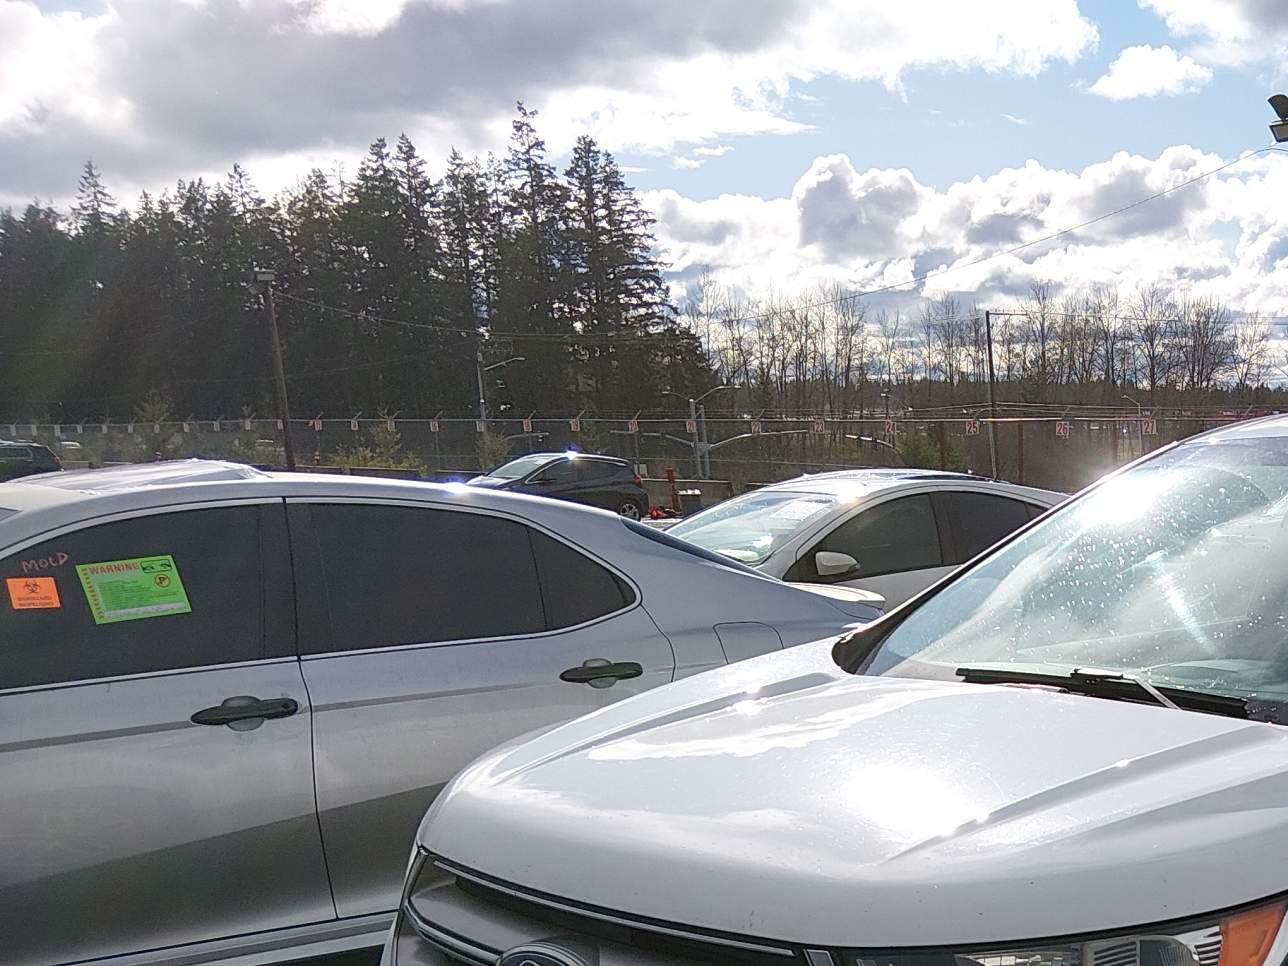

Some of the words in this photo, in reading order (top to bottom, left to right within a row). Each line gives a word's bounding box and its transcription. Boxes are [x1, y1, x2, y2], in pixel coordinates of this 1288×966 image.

[815, 422, 824, 433] 23
[886, 422, 896, 433] 24
[966, 422, 978, 434] 25
[1057, 422, 1069, 434] 26
[1143, 421, 1154, 434] 27
[88, 562, 140, 575] WARNING
